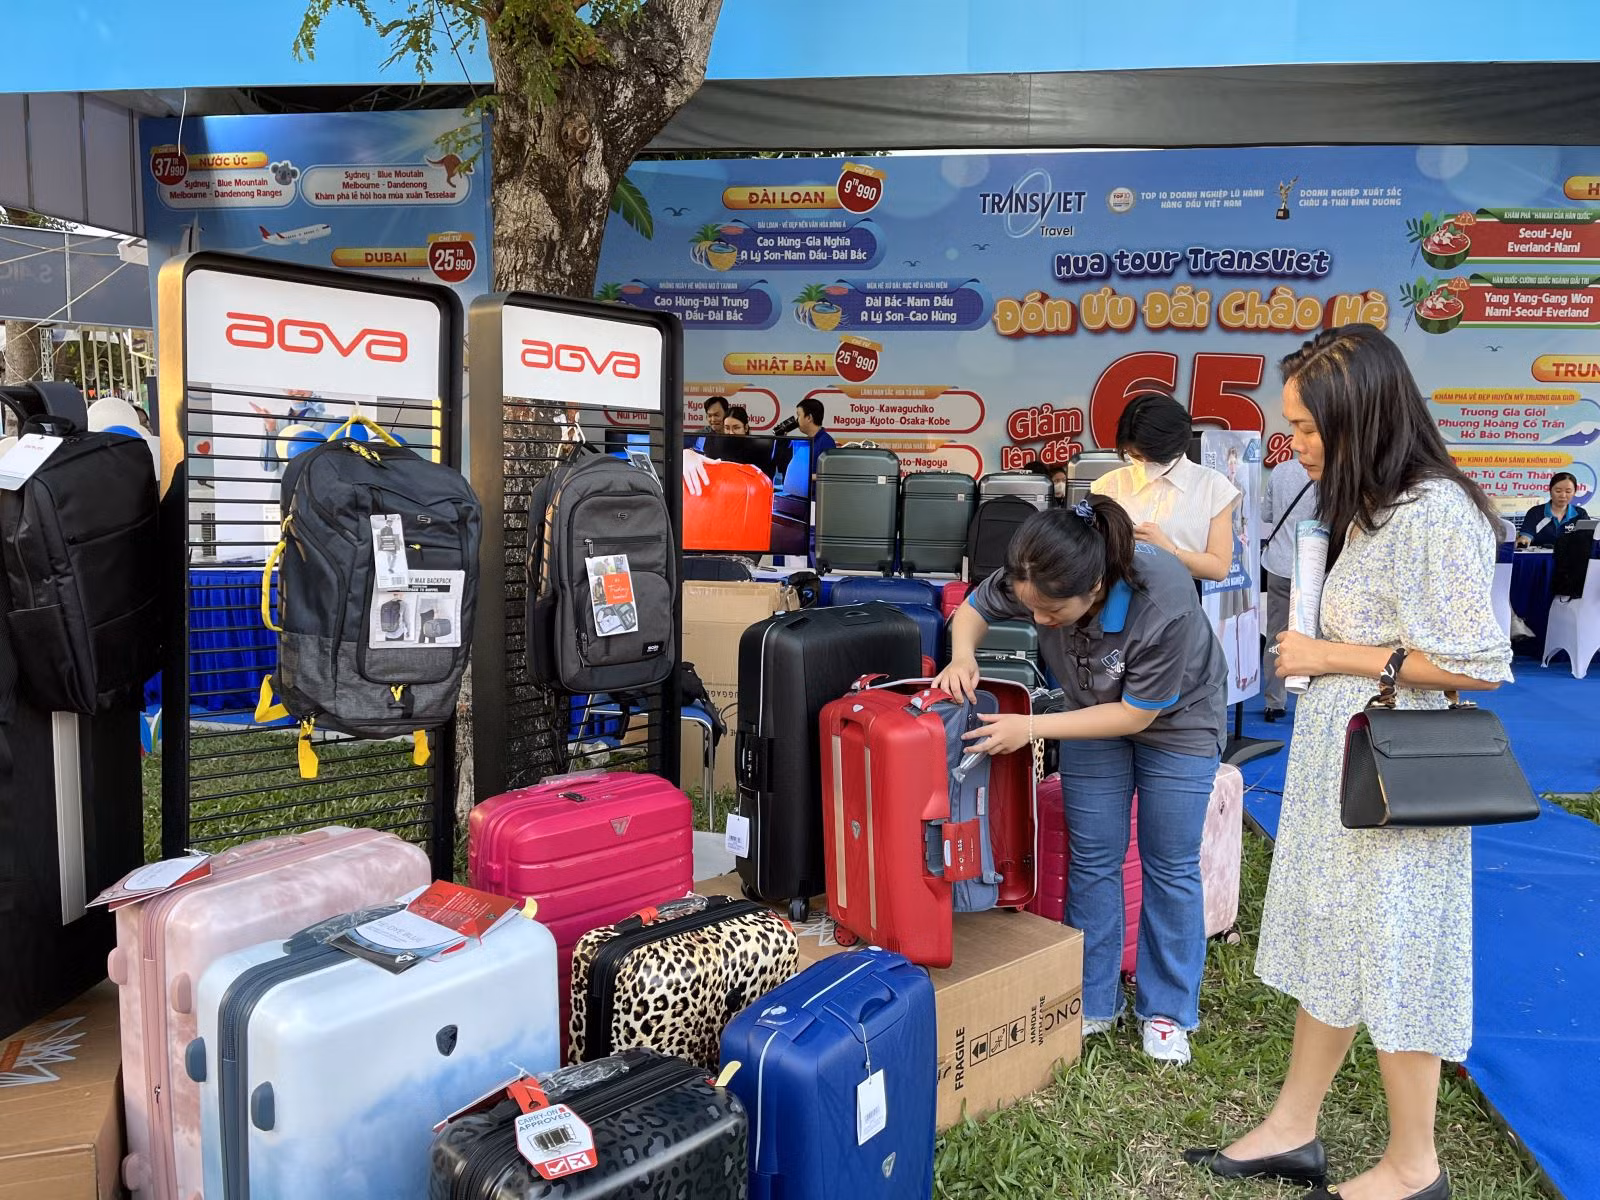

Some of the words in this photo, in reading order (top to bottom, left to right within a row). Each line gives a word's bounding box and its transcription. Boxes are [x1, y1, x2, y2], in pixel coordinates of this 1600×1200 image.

[200, 155, 230, 167] NƯỚC
[155, 158, 172, 177] 37
[170, 166, 184, 176] 990
[345, 171, 370, 180] Sydney
[185, 180, 210, 189] Sydney
[217, 179, 232, 187] Blue
[234, 178, 268, 186] Mountain
[387, 181, 427, 190] Dandenong
[169, 190, 207, 199] Melbourne
[214, 190, 255, 199] Dandenong
[256, 189, 282, 198] Ranges
[373, 192, 387, 200] hoa
[425, 191, 457, 199] Tesselaar
[748, 189, 776, 204] ĐÀI
[781, 191, 825, 204] LOAN
[1141, 192, 1156, 200] TOP
[1170, 191, 1198, 199] DOANH
[1200, 190, 1228, 199] NGHIỆP
[1300, 189, 1328, 197] DOANH
[1331, 188, 1360, 198] NGHIỆP
[980, 186, 1087, 218] TRANSVIET
[1205, 200, 1220, 208] VIỆT
[1224, 200, 1242, 208] NAM
[1040, 224, 1074, 237] Travel
[757, 236, 774, 246] Cao
[824, 236, 851, 248] Nghĩa
[365, 252, 407, 263] DUBAI
[434, 249, 455, 271] 25
[455, 259, 472, 271] 990
[740, 251, 748, 260] A
[850, 248, 867, 260] Bắc
[1055, 252, 1106, 278] Mua
[1114, 248, 1180, 273] tour
[1189, 247, 1330, 275] TransViet
[654, 296, 672, 306] Cao
[722, 296, 749, 308] Trung
[1484, 292, 1510, 305] Yang
[1571, 293, 1594, 304] Won
[726, 308, 743, 320] Bắc
[994, 292, 1072, 333] Đón
[1080, 287, 1136, 329] Ưu
[1142, 283, 1211, 329] Đãi
[1218, 286, 1323, 331] Chào
[1331, 289, 1388, 330] Hè
[860, 311, 868, 321] A
[746, 357, 790, 374] NHẬT
[794, 355, 826, 372] BẢN
[1552, 362, 1600, 378] TRUN
[1090, 351, 1265, 450] 65
[1502, 408, 1520, 416] Gia
[1008, 404, 1083, 441] Giảm
[1504, 430, 1540, 441] Phong
[1002, 446, 1035, 471] lên
[1041, 440, 1083, 465] đến
[1527, 471, 1553, 479] Thàn
[1030, 1005, 1038, 1044] HANDLE
[954, 1026, 965, 1091] FRAGILE
[517, 1108, 558, 1126] CARRY-ON
[519, 1112, 572, 1132] APPROVED
